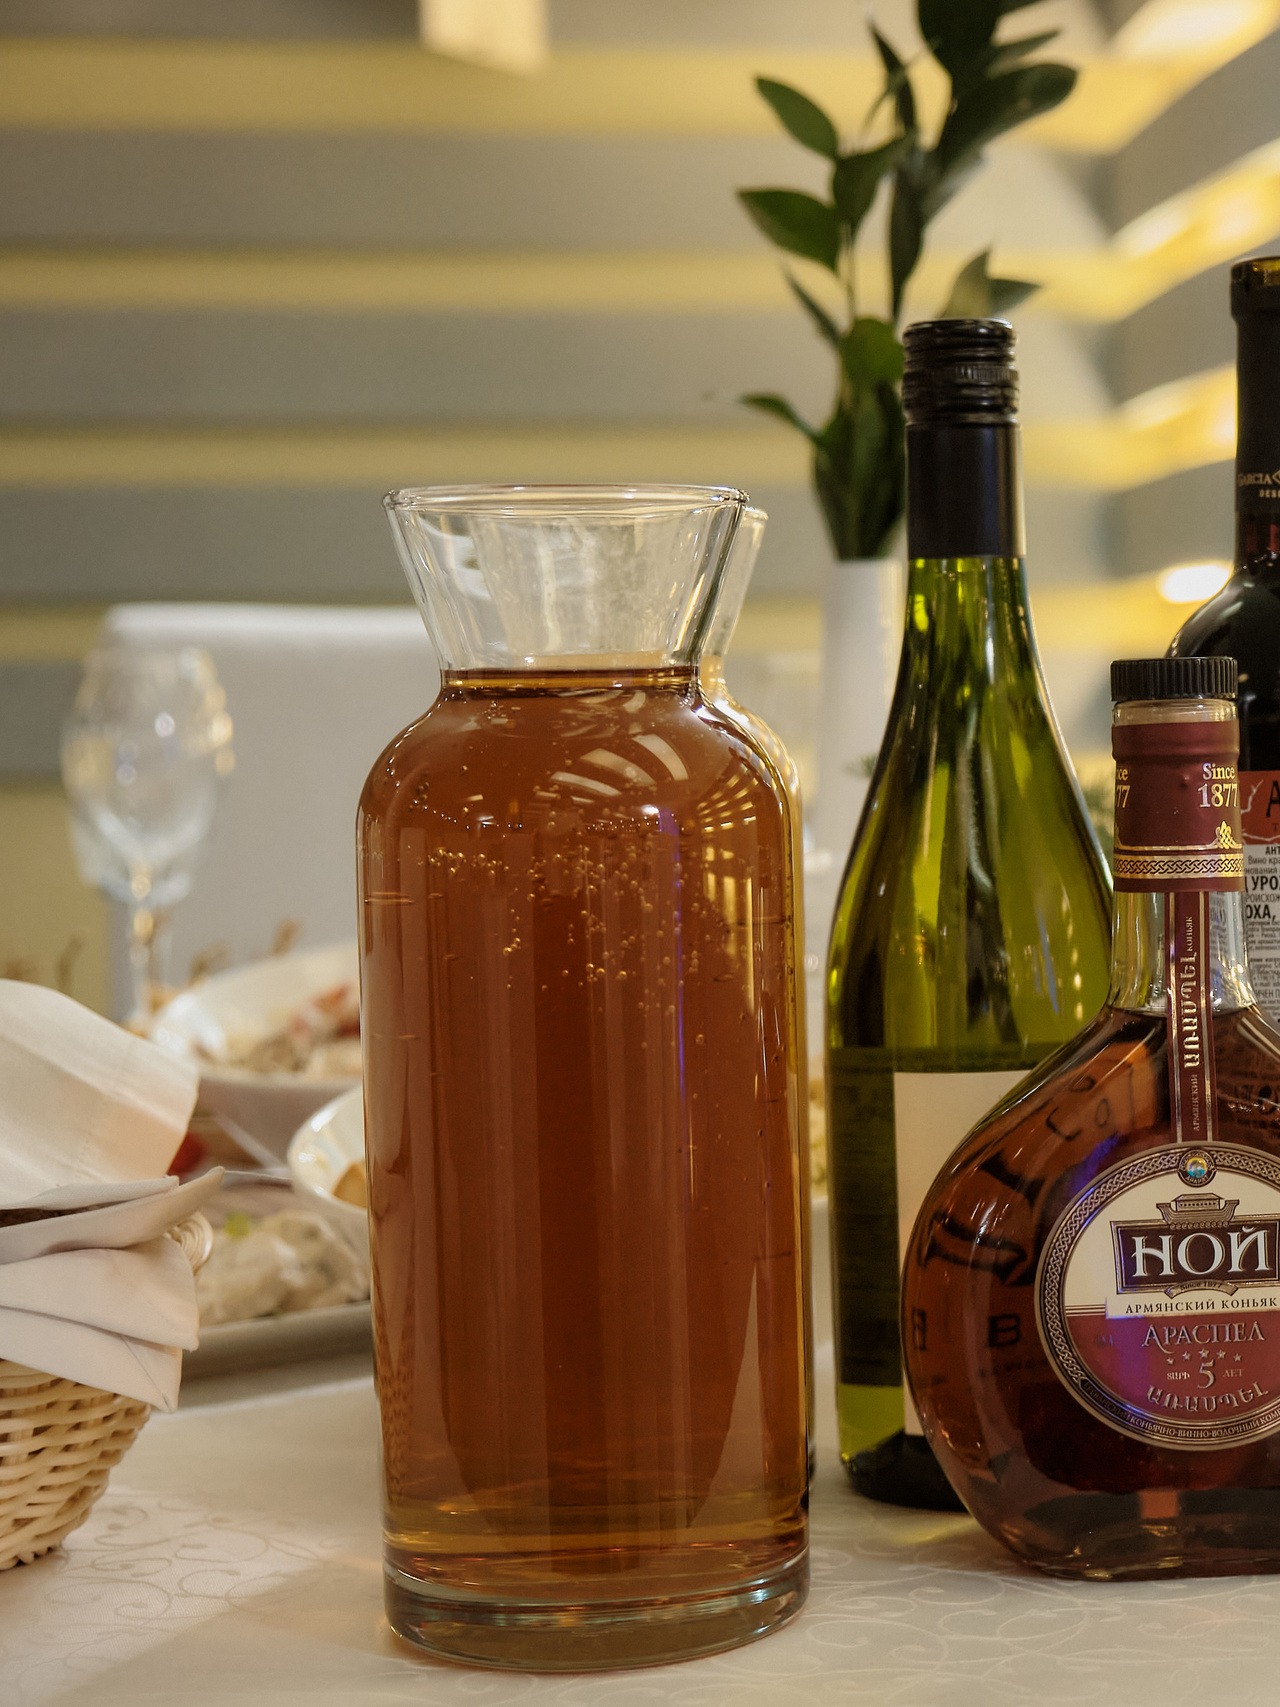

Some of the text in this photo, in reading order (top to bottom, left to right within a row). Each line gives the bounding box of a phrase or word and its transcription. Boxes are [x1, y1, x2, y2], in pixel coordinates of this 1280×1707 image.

[1202, 762, 1237, 780] Since
[1197, 782, 1238, 808] 1877
[1248, 855, 1267, 865] Вино
[1244, 866, 1278, 875] нования
[1245, 903, 1276, 922] ОХА,
[1186, 915, 1194, 952] КОНЬЯК
[1255, 988, 1274, 998] ИЧЕН
[1131, 1225, 1273, 1278] НОЙ
[1125, 1297, 1278, 1314] АРМЯНСКИЙ КОНЬЯК
[1141, 1320, 1265, 1354] АРАСПЕЛ
[1196, 1358, 1216, 1390] 5
[1222, 1367, 1245, 1378] ЛЕТ
